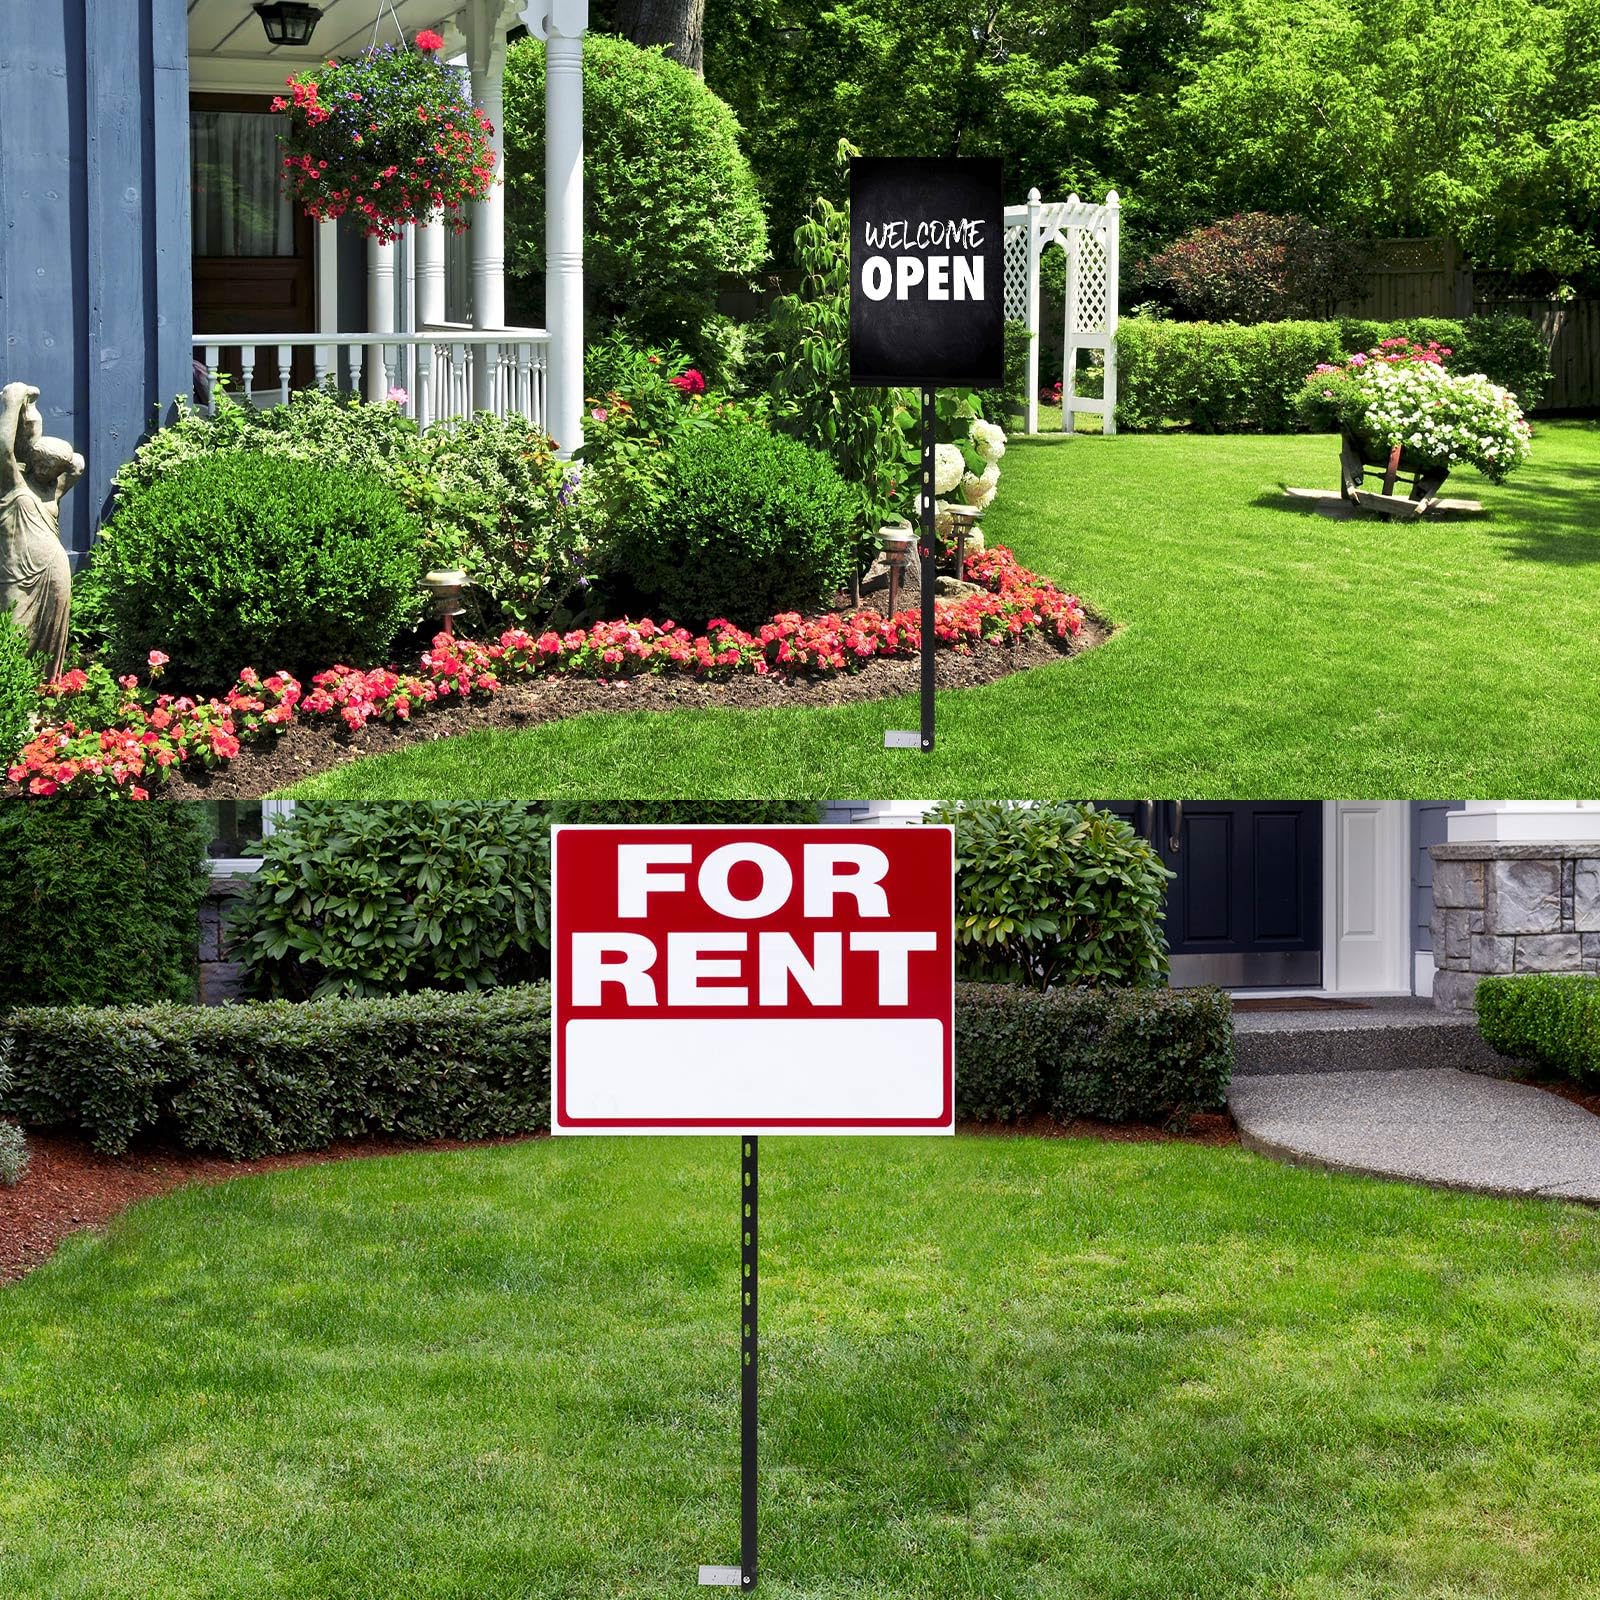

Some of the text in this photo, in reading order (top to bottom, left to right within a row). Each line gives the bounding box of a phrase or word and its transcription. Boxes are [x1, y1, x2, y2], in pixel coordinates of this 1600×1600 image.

[865, 218, 985, 250] WELCOME
[861, 255, 985, 302] OPEN
[617, 842, 891, 920] FOR
[571, 931, 937, 1007] RENT
